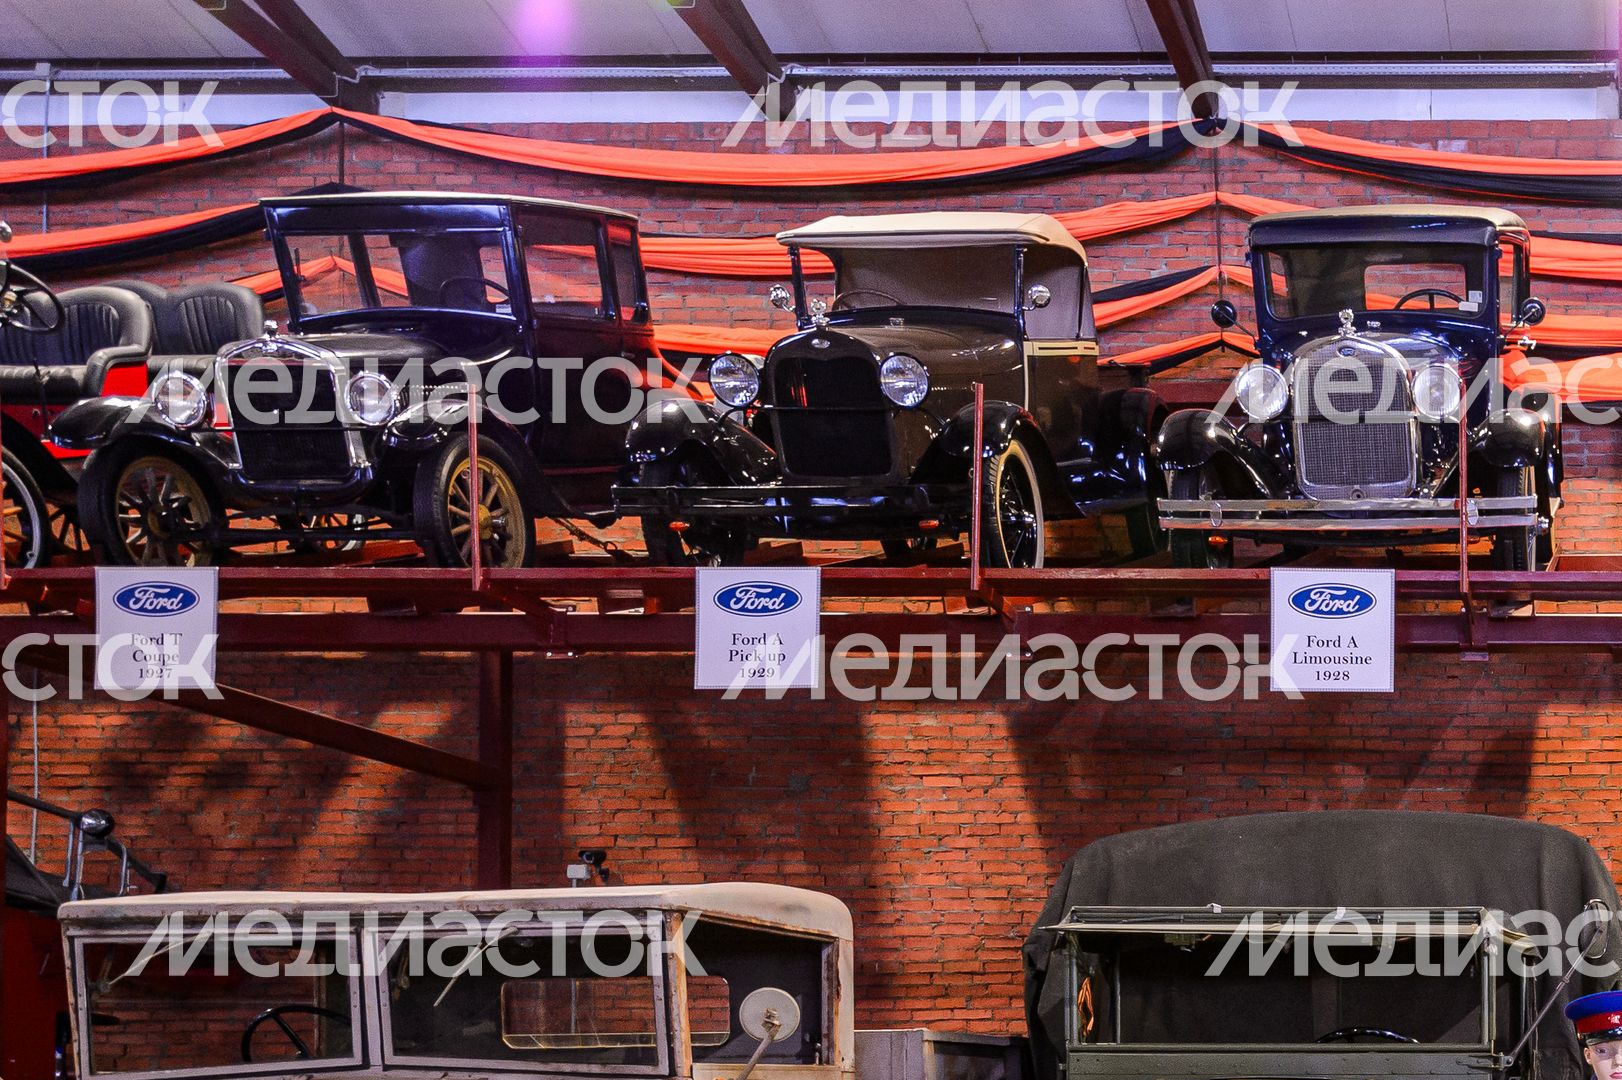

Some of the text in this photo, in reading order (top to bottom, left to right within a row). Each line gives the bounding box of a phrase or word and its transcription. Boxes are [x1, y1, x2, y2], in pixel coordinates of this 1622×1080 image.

[129, 586, 184, 610] Ford
[730, 586, 786, 610] Ford
[1304, 588, 1361, 612] Ford
[131, 633, 183, 646] Ford T
[731, 632, 784, 646] Ford A
[1306, 635, 1359, 648] Ford A
[132, 649, 180, 666] Coupe
[728, 649, 786, 666] Pick up
[1293, 651, 1373, 665] Limousine
[139, 668, 173, 679] 1927
[740, 667, 775, 679] 1929
[1315, 670, 1351, 682] 1928
